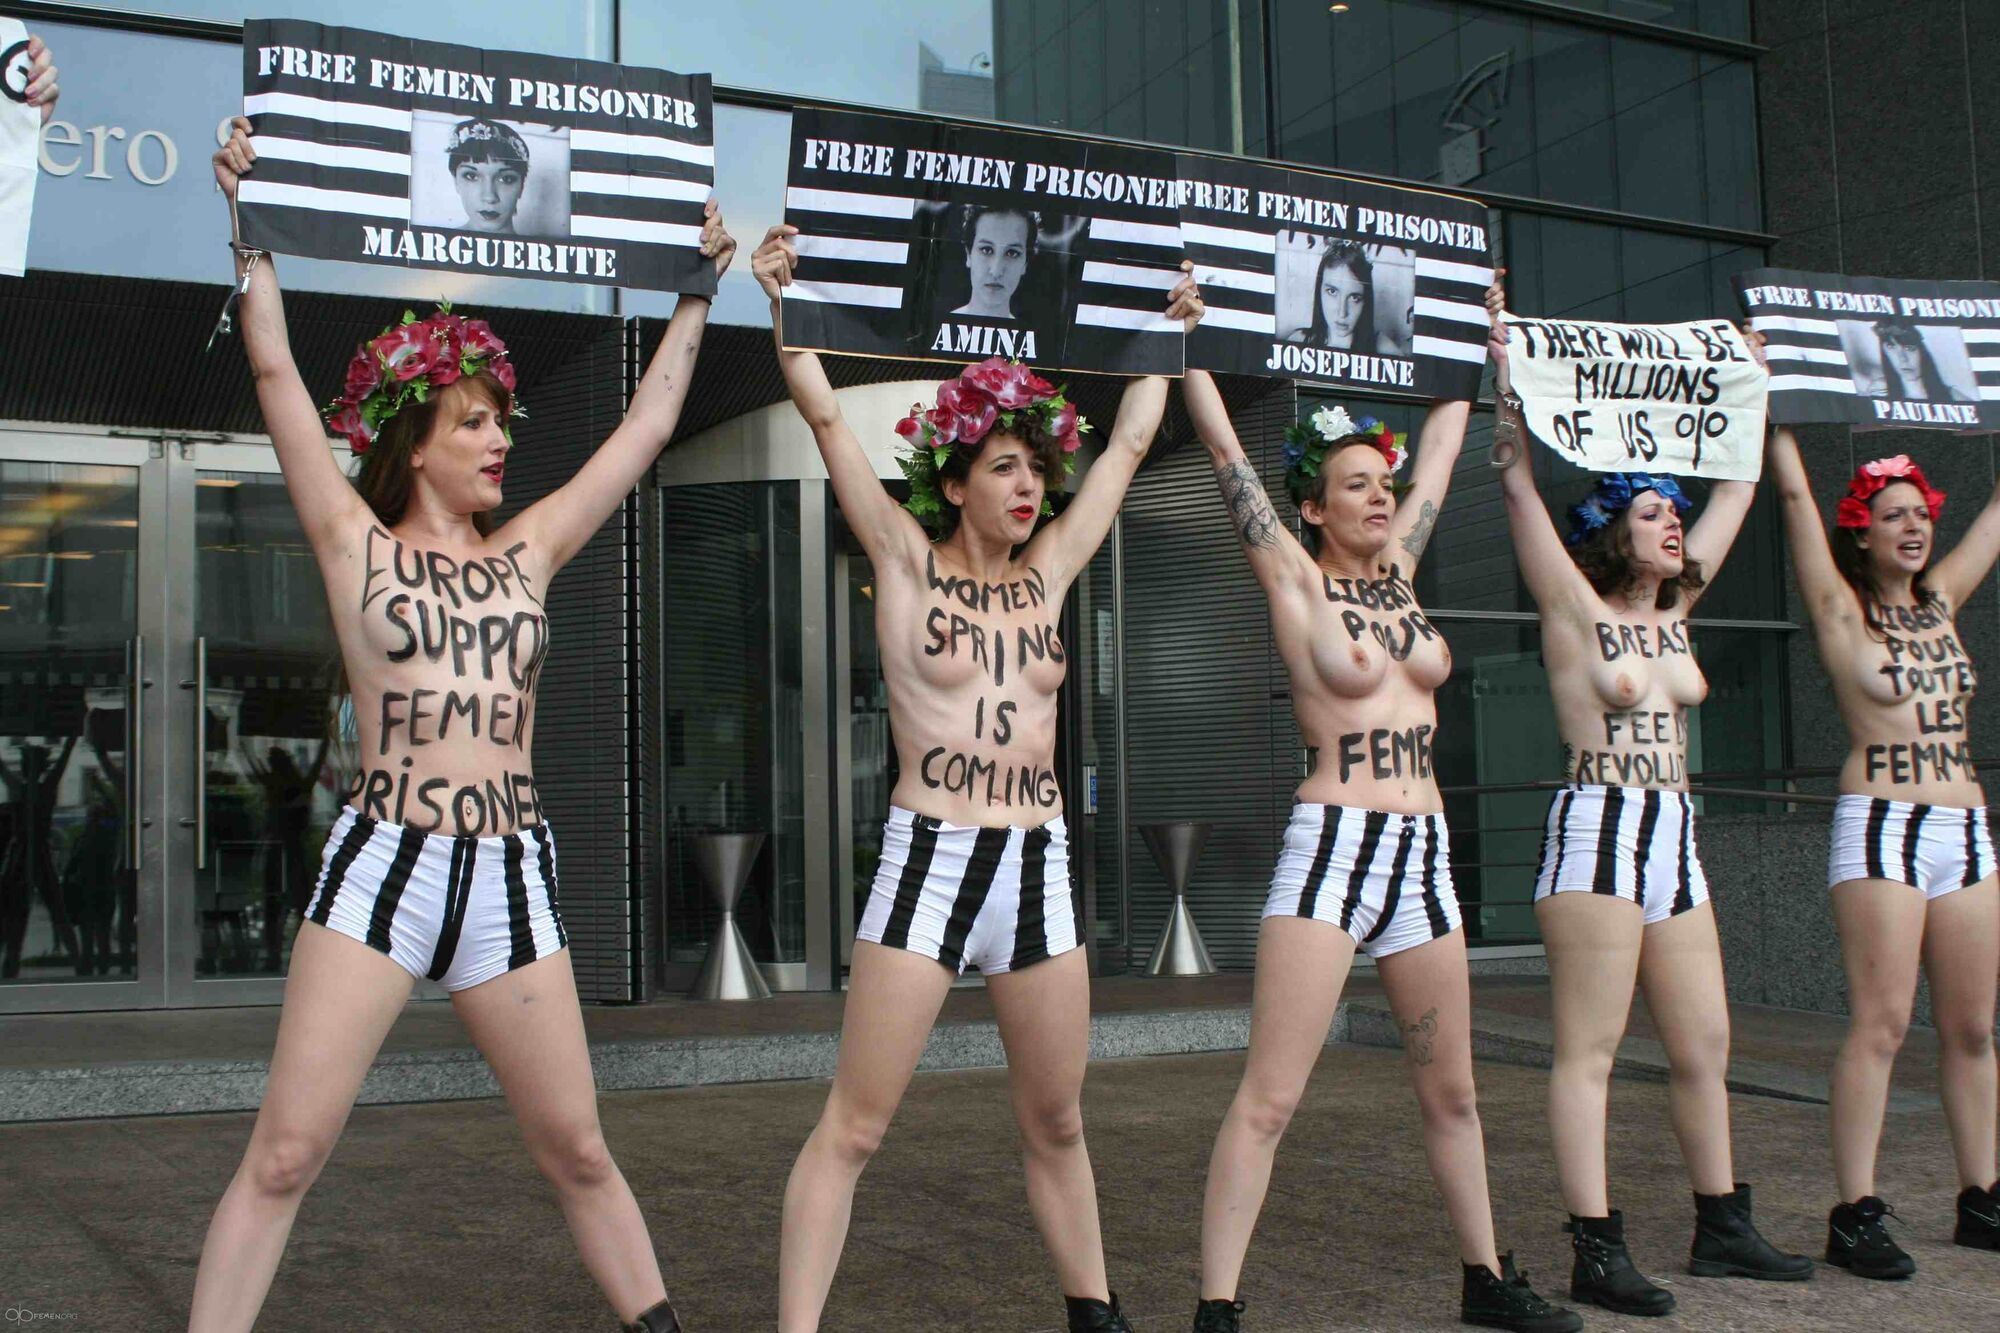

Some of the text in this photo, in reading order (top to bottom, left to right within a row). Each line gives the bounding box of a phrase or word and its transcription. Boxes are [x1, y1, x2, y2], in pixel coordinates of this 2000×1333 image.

[258, 46, 699, 129] FREE FEMEN PRISONER
[803, 138, 894, 177] FREE
[903, 149, 1016, 190] FEMEN
[1176, 179, 1488, 252] FREE FEMEN PRISONER
[361, 225, 617, 278] MARGUERITE
[1744, 285, 1812, 307] FREE
[1813, 289, 1896, 315] FEMEN
[931, 323, 1037, 360] AMINA
[1266, 343, 1415, 387] JOSEPHINE
[1511, 321, 1750, 363] THERE WILL BE
[1575, 362, 1721, 407] MILLIONS
[1552, 409, 1660, 463] OF US
[1873, 399, 1980, 424] PAULINE
[926, 549, 1046, 614] WOMEN
[924, 606, 1065, 687] SPRING
[1887, 634, 1968, 664] POUR
[379, 688, 529, 756] FEMEN
[975, 696, 1017, 746] IS
[1915, 699, 1965, 734] LES
[921, 746, 1058, 808] COMING
